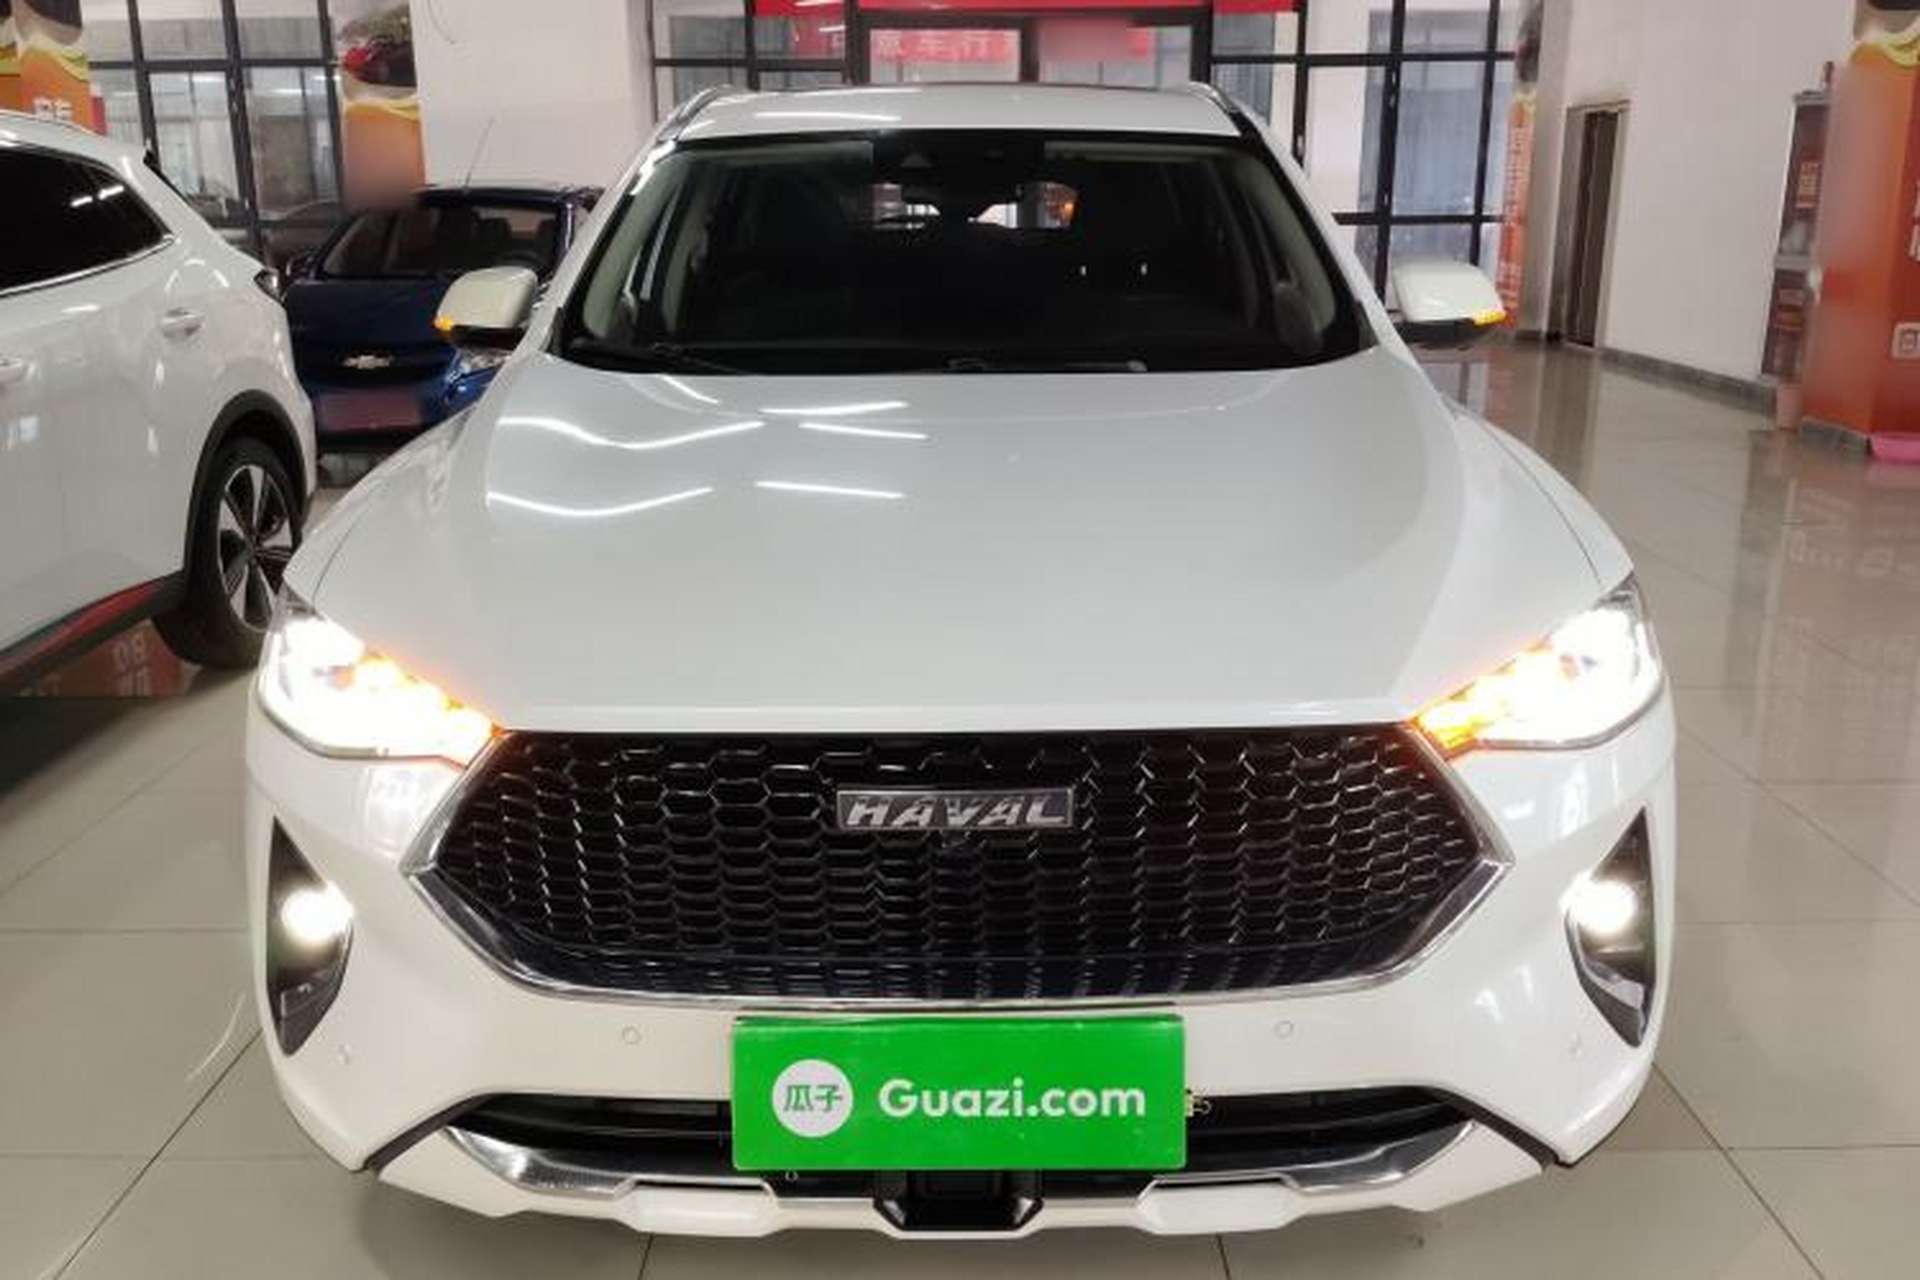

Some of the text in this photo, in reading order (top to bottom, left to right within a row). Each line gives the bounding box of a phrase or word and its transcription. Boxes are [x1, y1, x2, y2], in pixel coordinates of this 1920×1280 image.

[847, 796, 1065, 826] HAVAL
[783, 1084, 842, 1113] 瓜子
[878, 1077, 1146, 1118] Guazi.com
